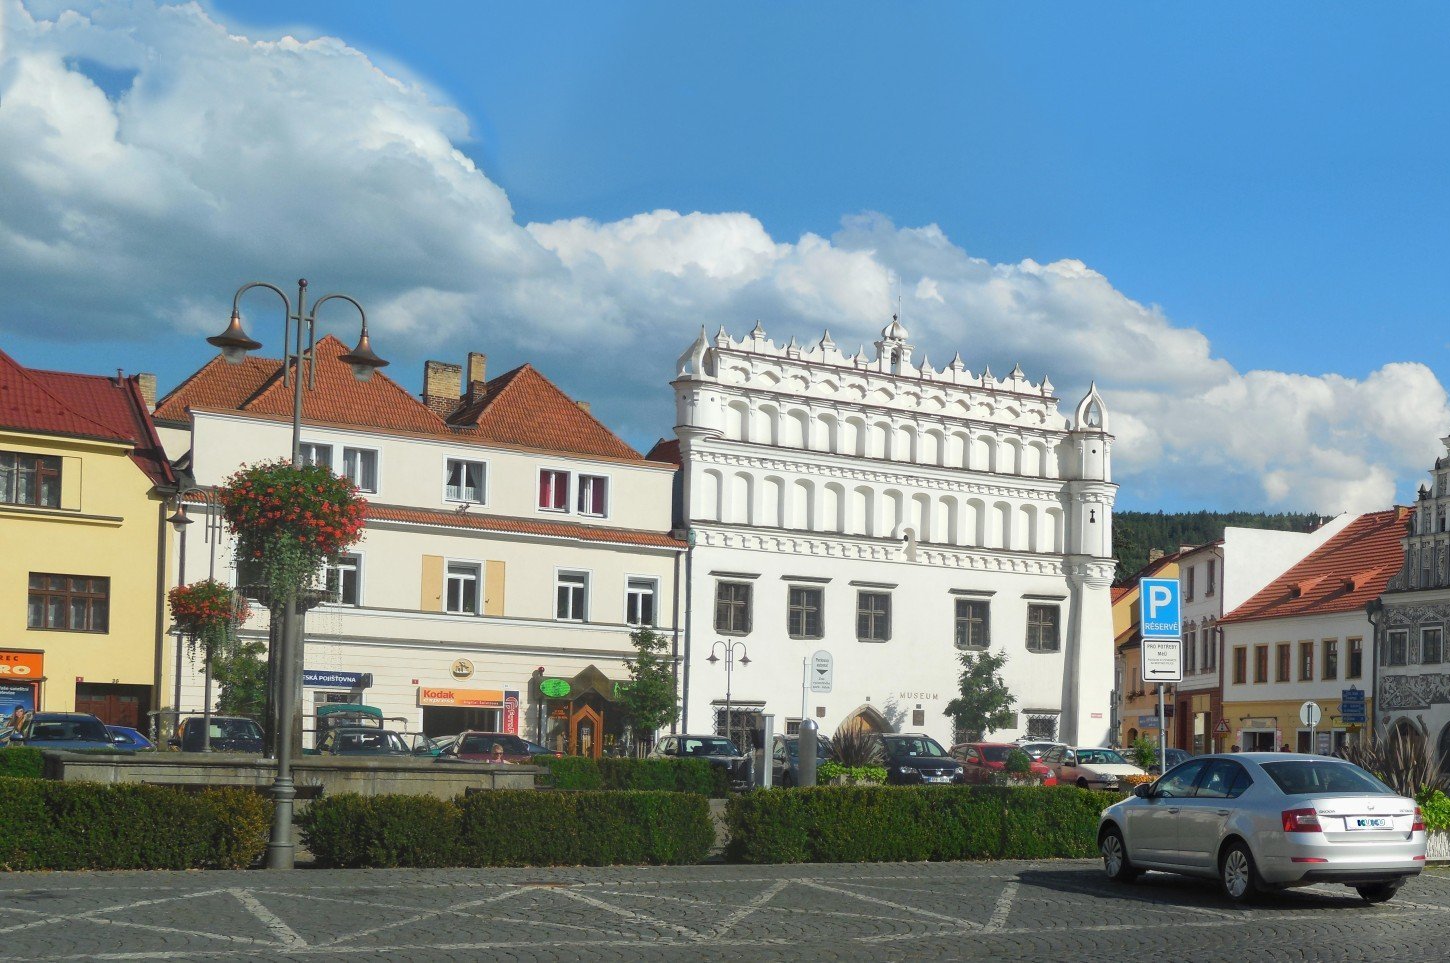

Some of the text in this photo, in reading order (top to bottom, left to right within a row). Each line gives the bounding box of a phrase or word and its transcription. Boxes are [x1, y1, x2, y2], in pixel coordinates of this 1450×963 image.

[1150, 586, 1172, 619] P
[1145, 622, 1178, 631] RÉSERVÉ
[423, 689, 455, 699] Kodak
[900, 692, 938, 700] MUSEUM
